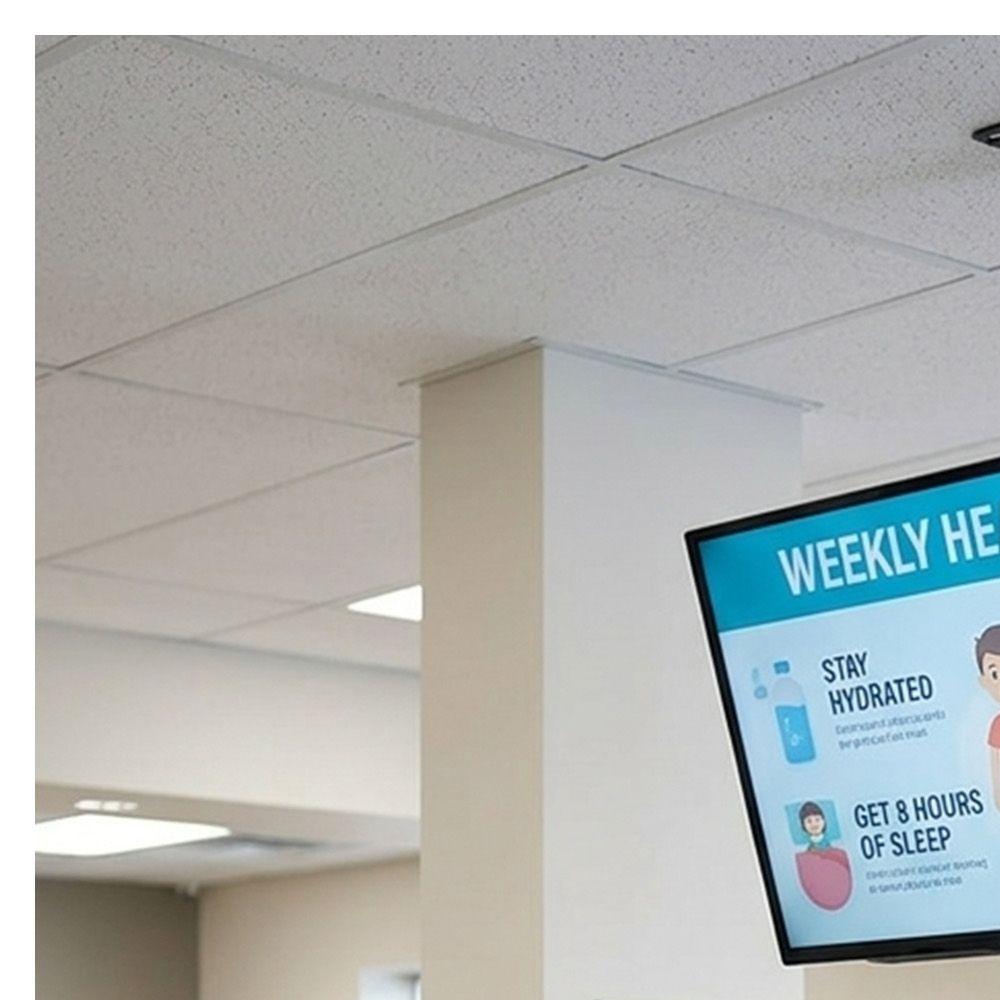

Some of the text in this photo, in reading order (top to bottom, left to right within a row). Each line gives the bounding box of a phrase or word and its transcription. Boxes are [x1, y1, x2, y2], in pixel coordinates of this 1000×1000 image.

[778, 517, 930, 596] WEEKLY
[821, 651, 868, 683] STAY
[827, 675, 933, 715] HYDRATED
[854, 788, 984, 829] GET 8 HOURS
[860, 825, 951, 860] OF SLEEP
